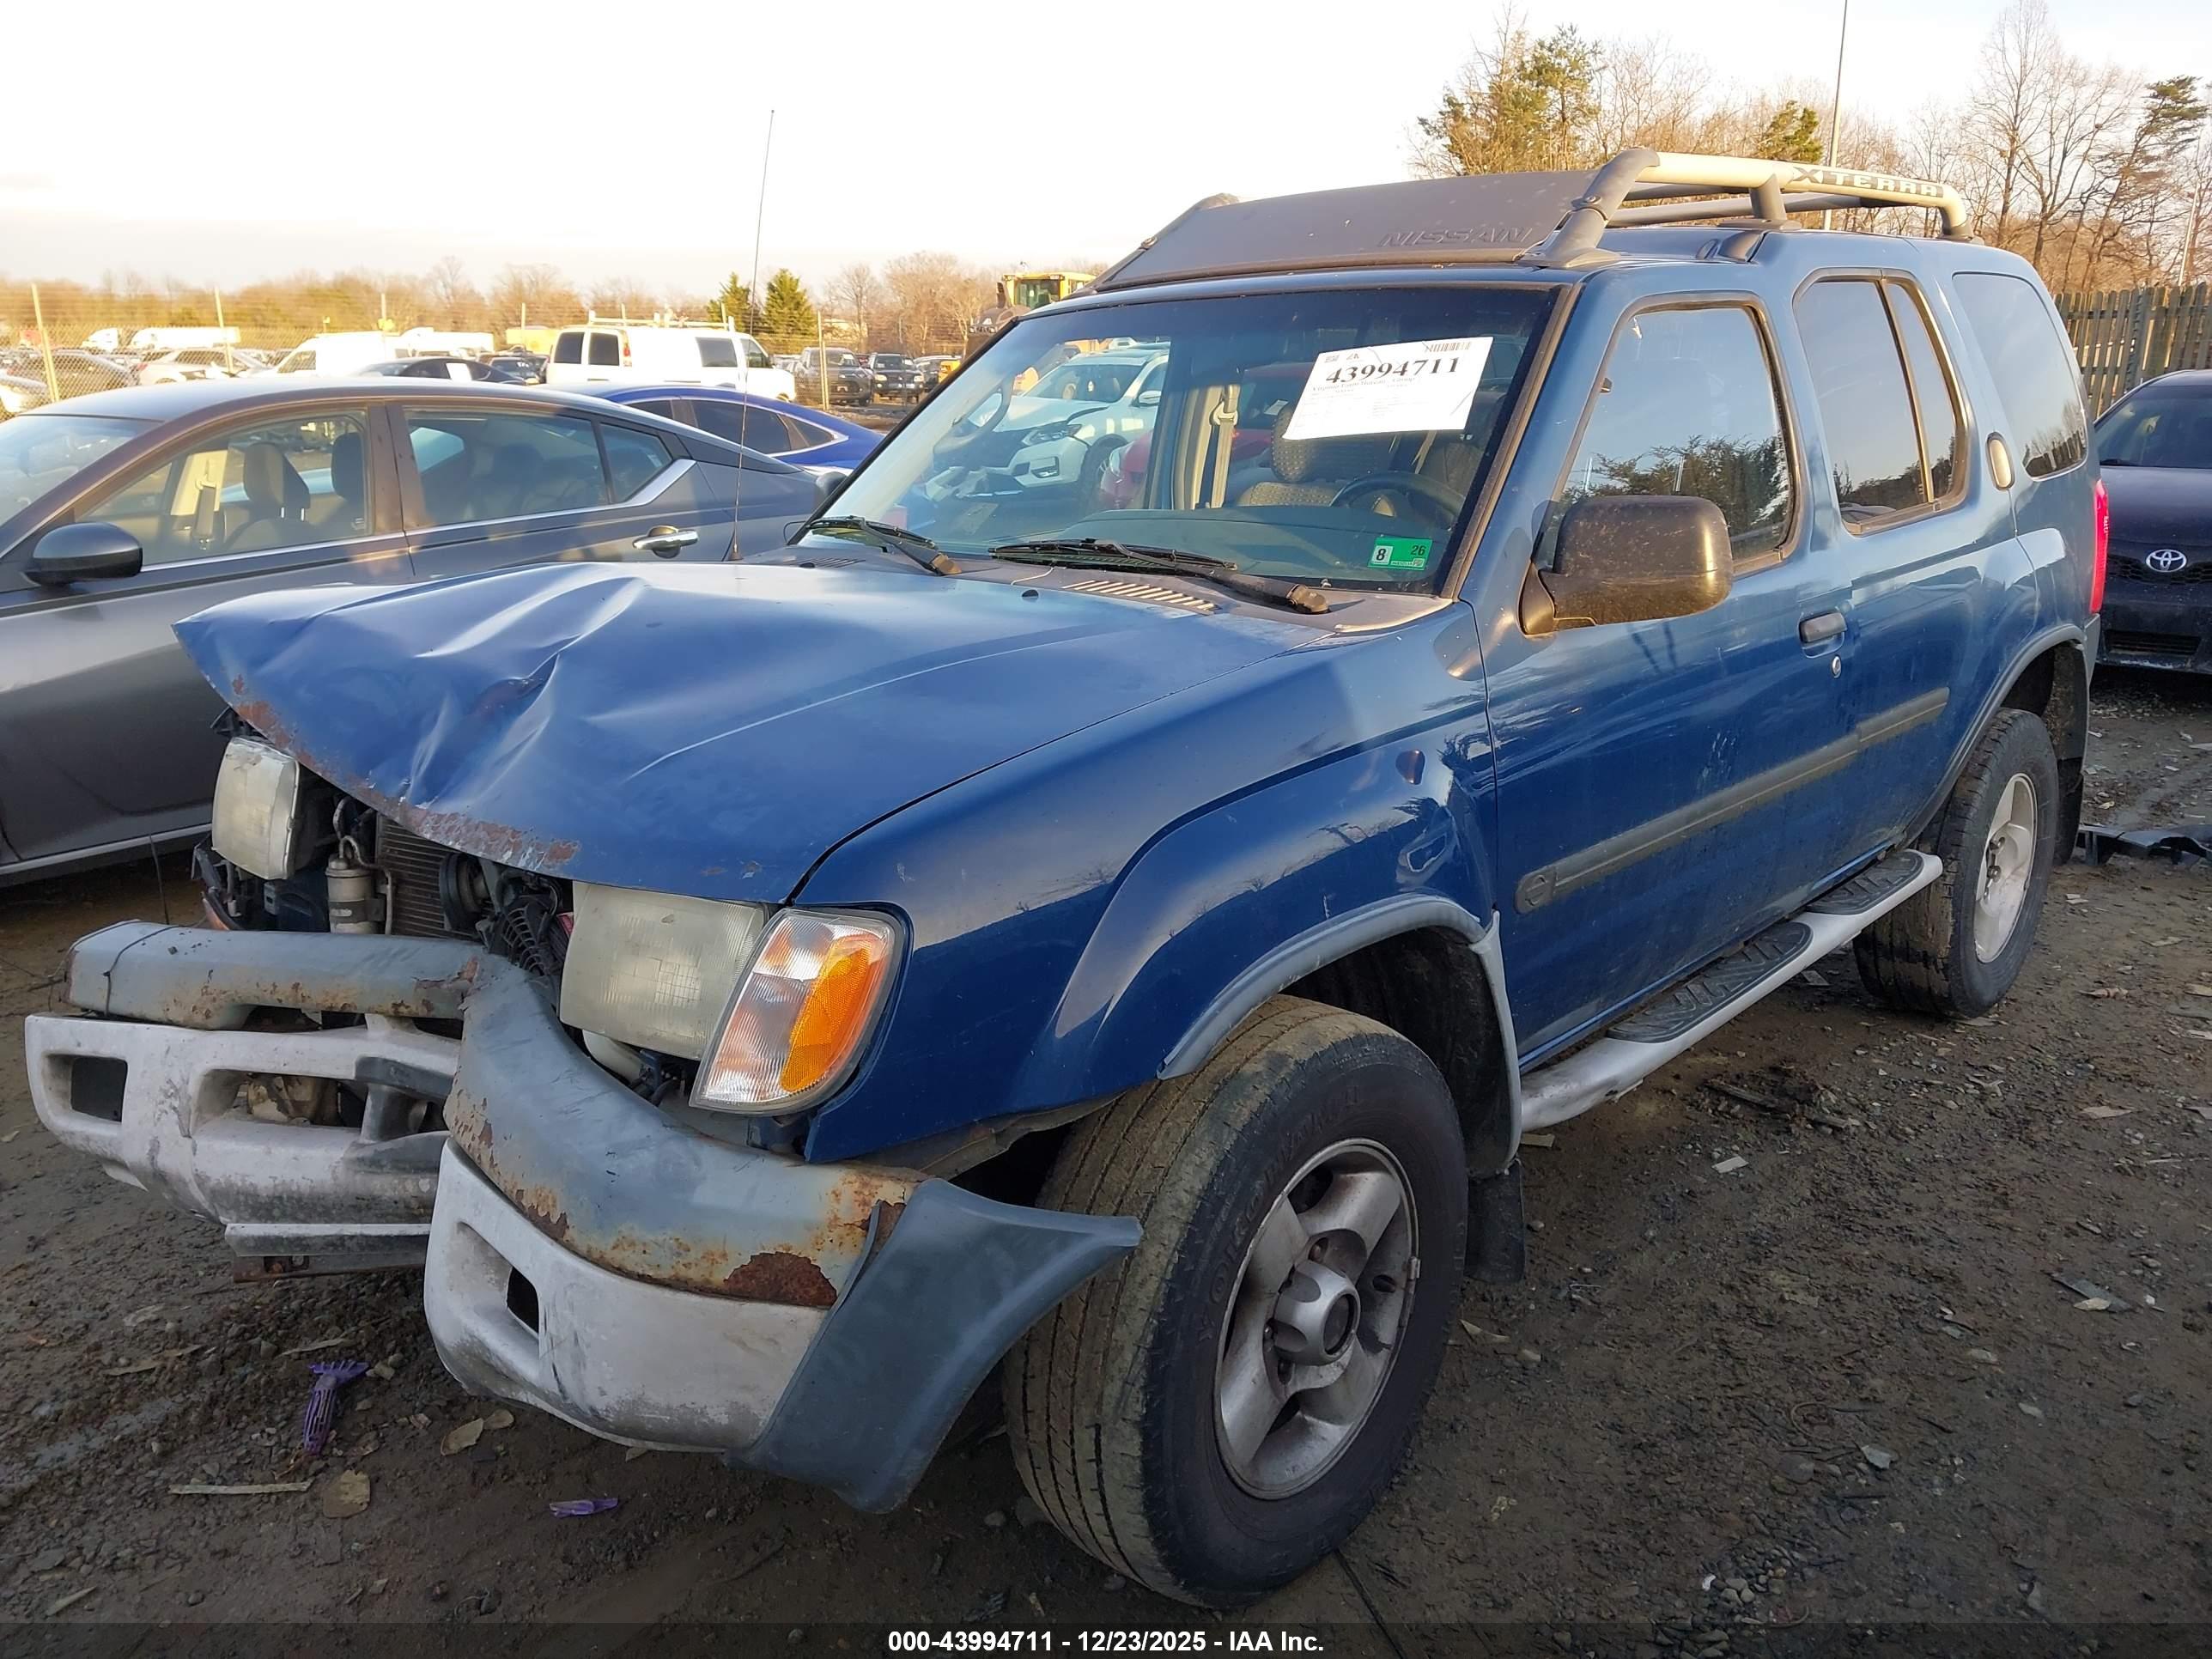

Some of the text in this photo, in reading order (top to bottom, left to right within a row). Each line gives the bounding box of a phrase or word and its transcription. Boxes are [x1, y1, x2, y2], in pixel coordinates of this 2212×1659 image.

[1788, 167, 1939, 197] XTERRA
[1377, 228, 1533, 247] NISSAN
[1326, 357, 1460, 384] 43994711
[1376, 548, 1387, 561] 8
[1411, 545, 1426, 556] 26
